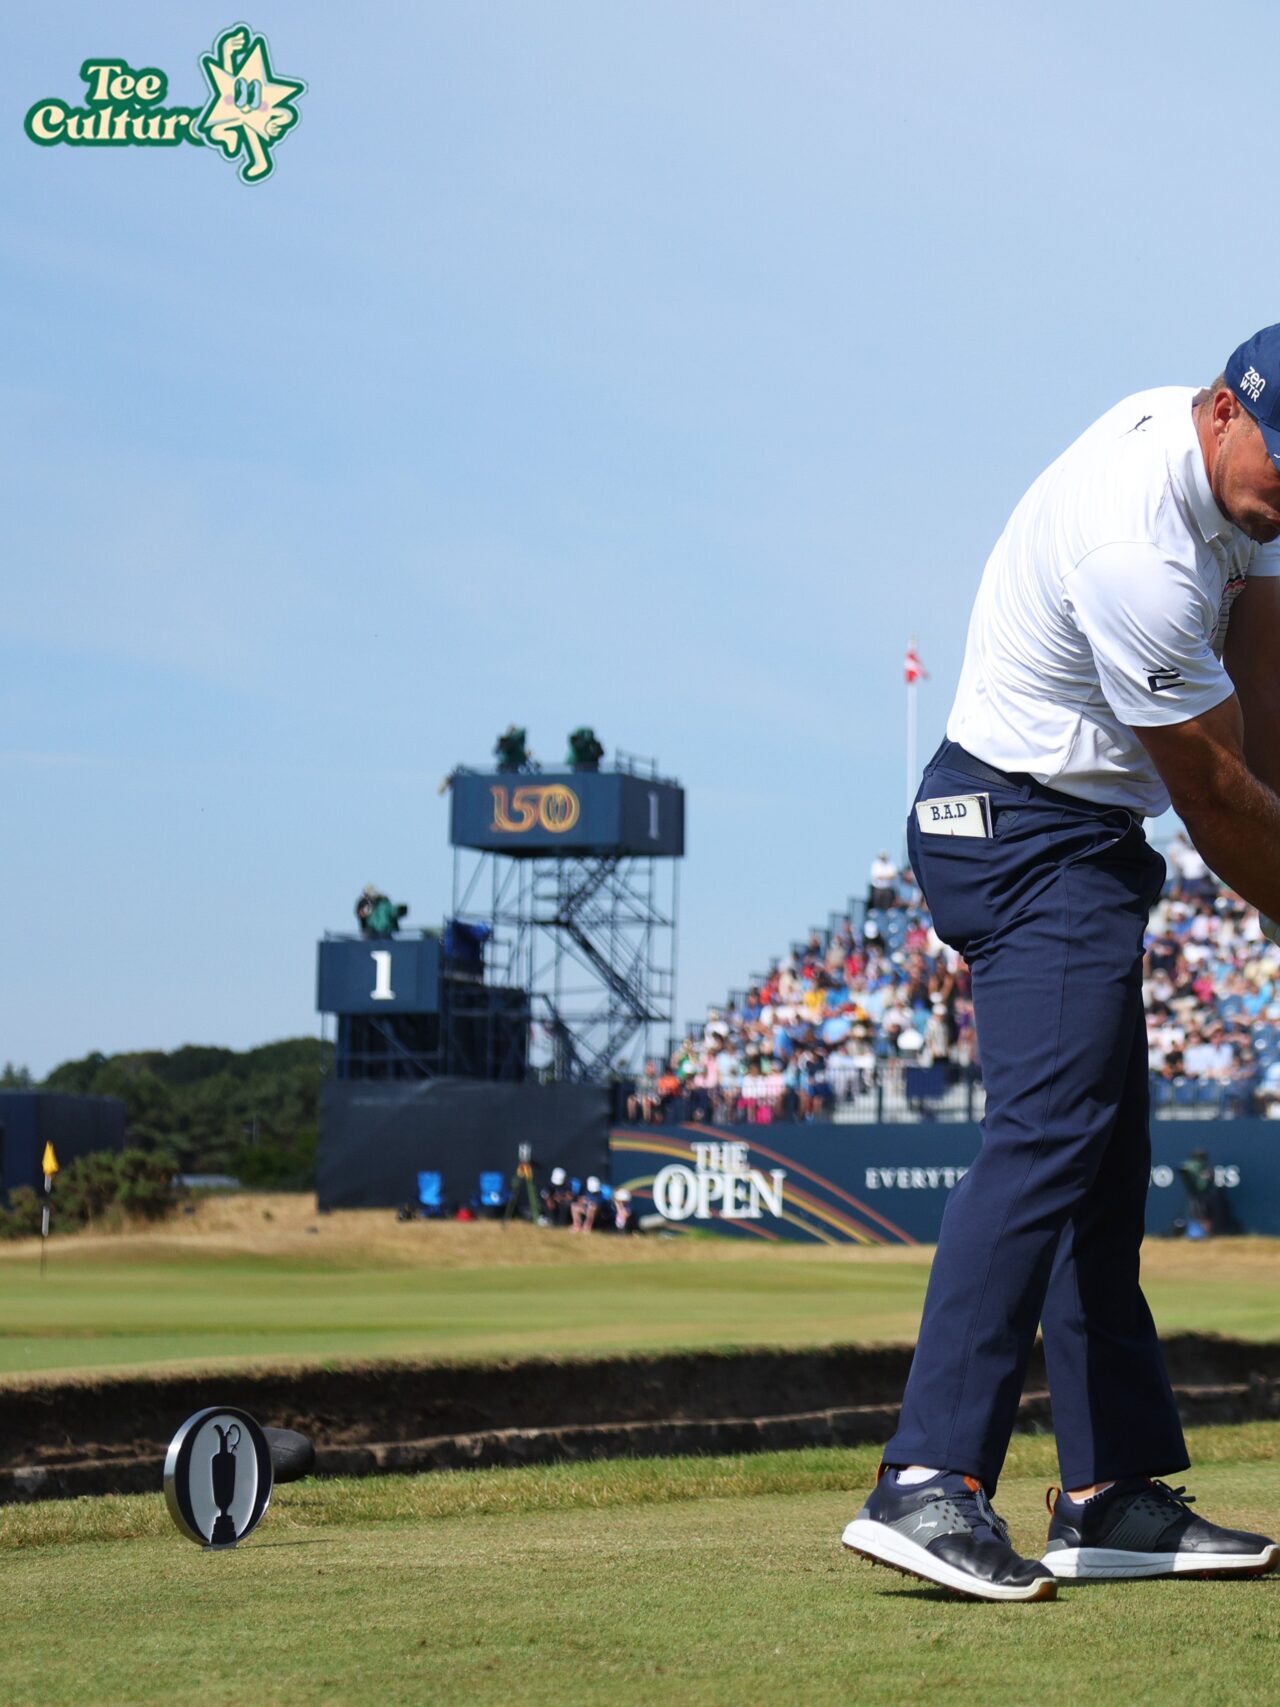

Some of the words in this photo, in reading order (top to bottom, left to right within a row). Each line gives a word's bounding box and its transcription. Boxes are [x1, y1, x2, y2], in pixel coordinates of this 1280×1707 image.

[1239, 376, 1260, 403] WTR
[490, 783, 581, 834] 150
[930, 802, 967, 821] B.A.D
[370, 949, 396, 1001] 1
[690, 1141, 750, 1173] THE
[652, 1163, 787, 1221] OPEN
